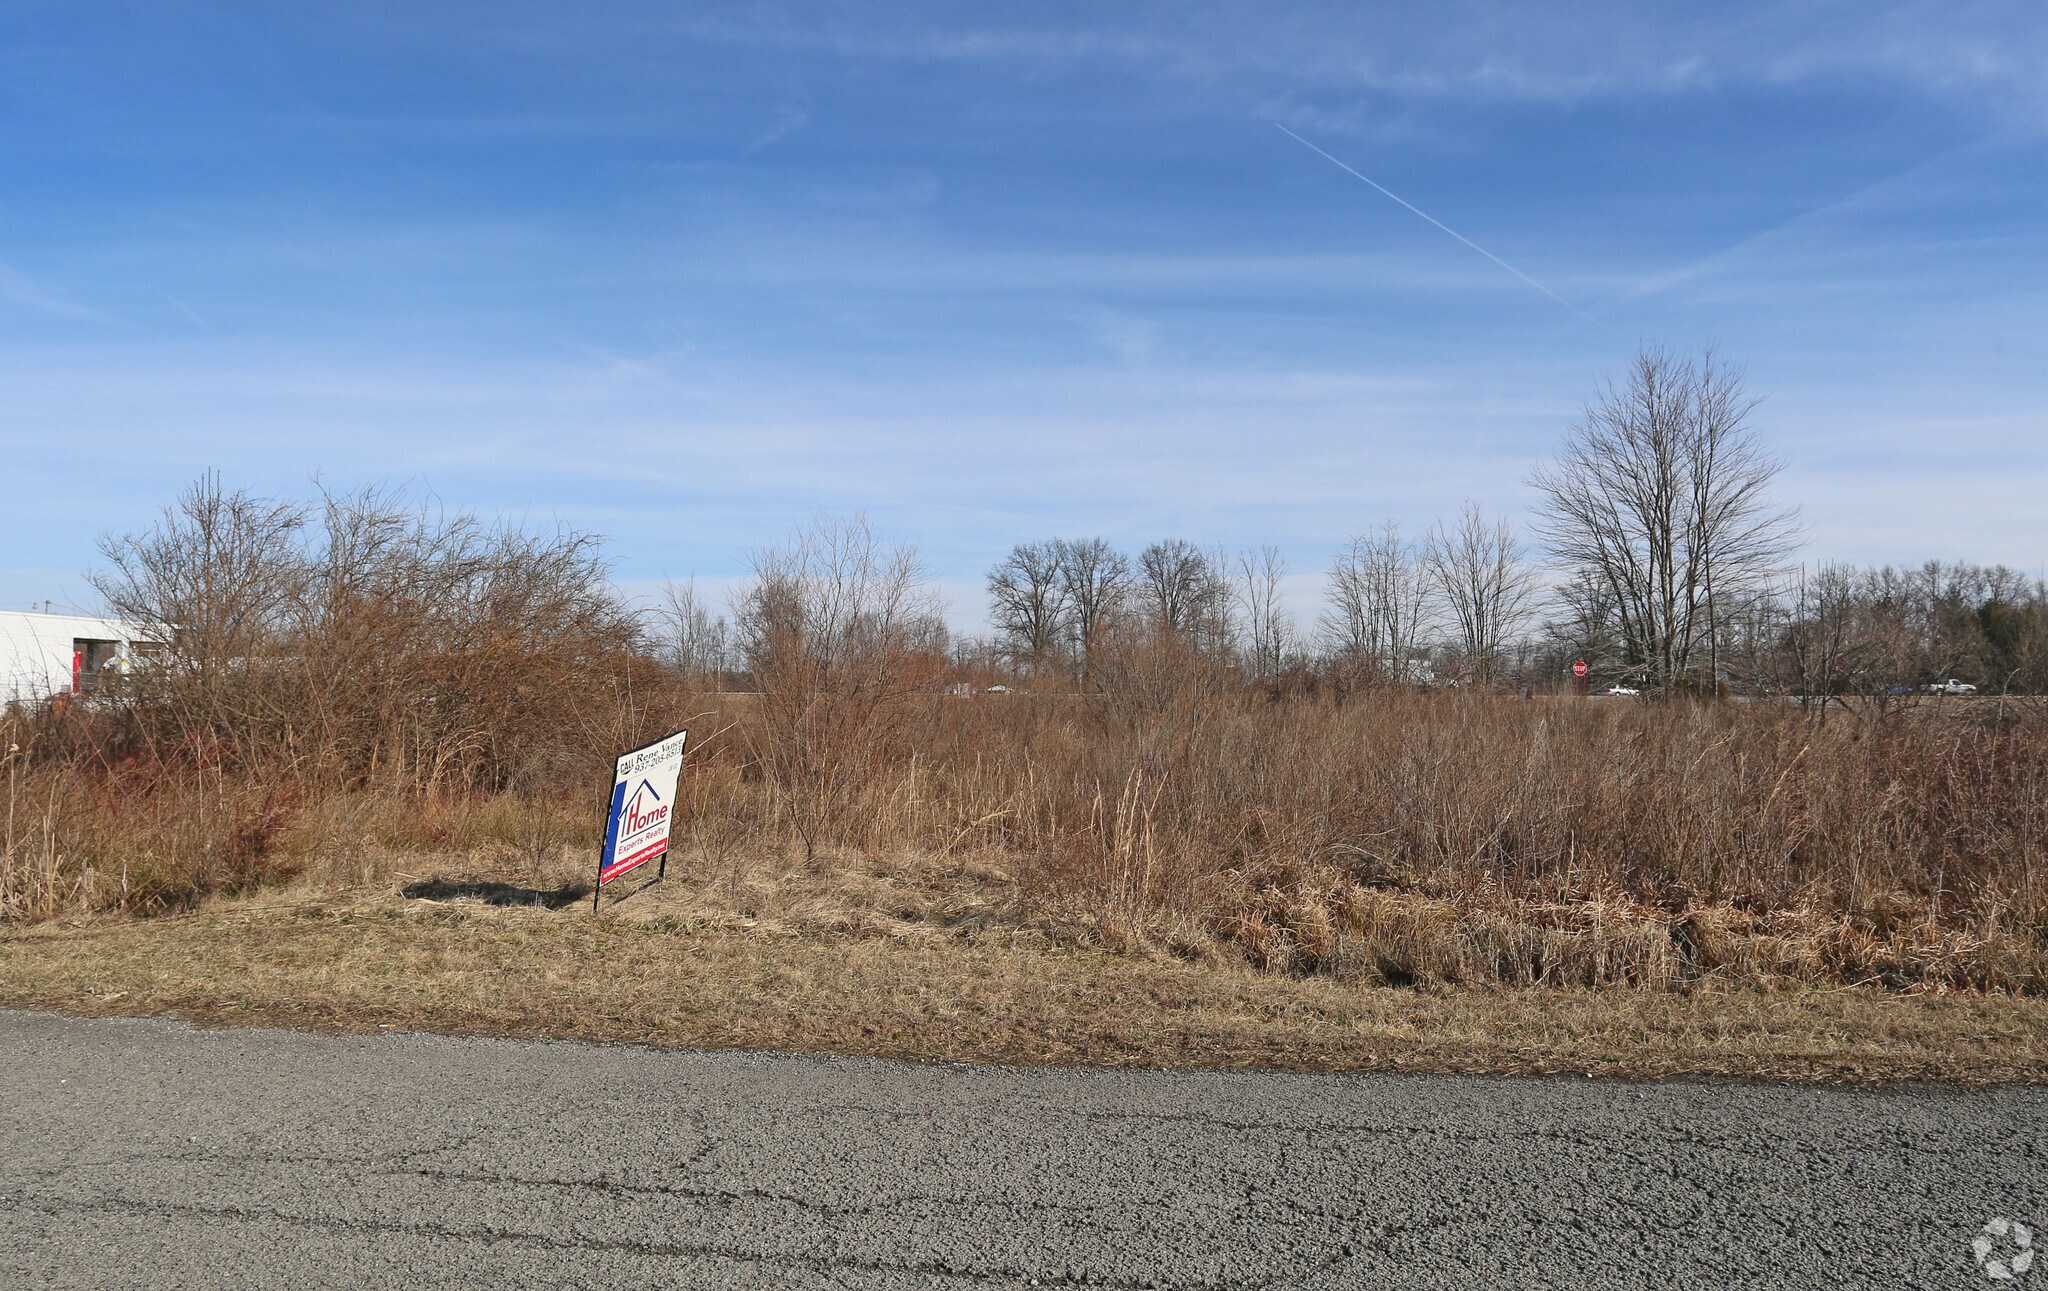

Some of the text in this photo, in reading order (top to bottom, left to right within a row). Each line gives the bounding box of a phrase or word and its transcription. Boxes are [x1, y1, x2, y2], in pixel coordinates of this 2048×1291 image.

[620, 738, 683, 773] CALL Rene Vance
[626, 791, 668, 835] Home
[618, 826, 666, 855] Experts Realty
